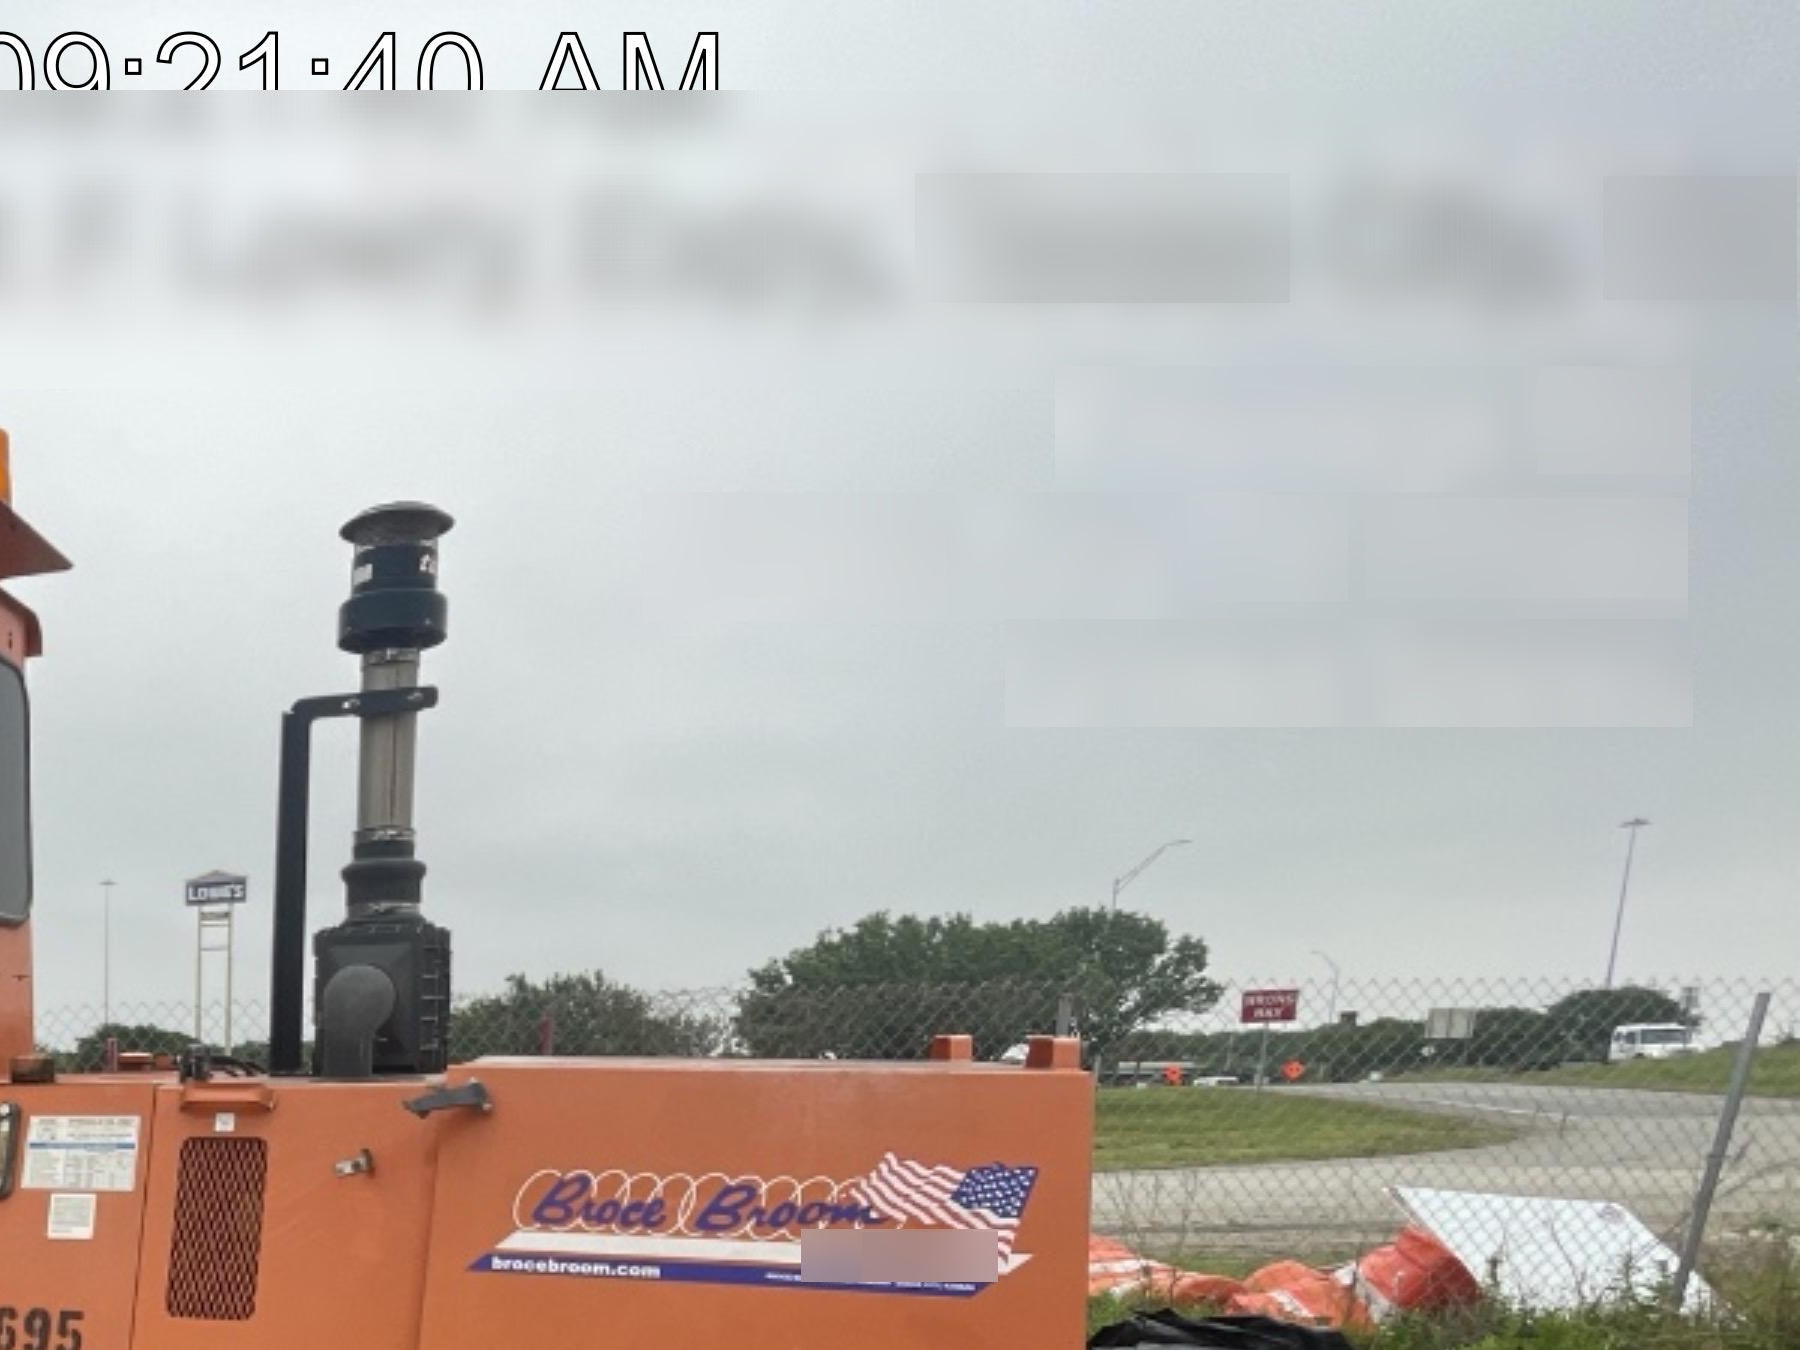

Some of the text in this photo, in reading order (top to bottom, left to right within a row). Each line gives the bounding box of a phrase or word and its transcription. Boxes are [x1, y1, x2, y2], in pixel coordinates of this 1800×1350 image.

[532, 1172, 889, 1232] Broce Broom
[490, 1255, 662, 1279] brocebroom.com
